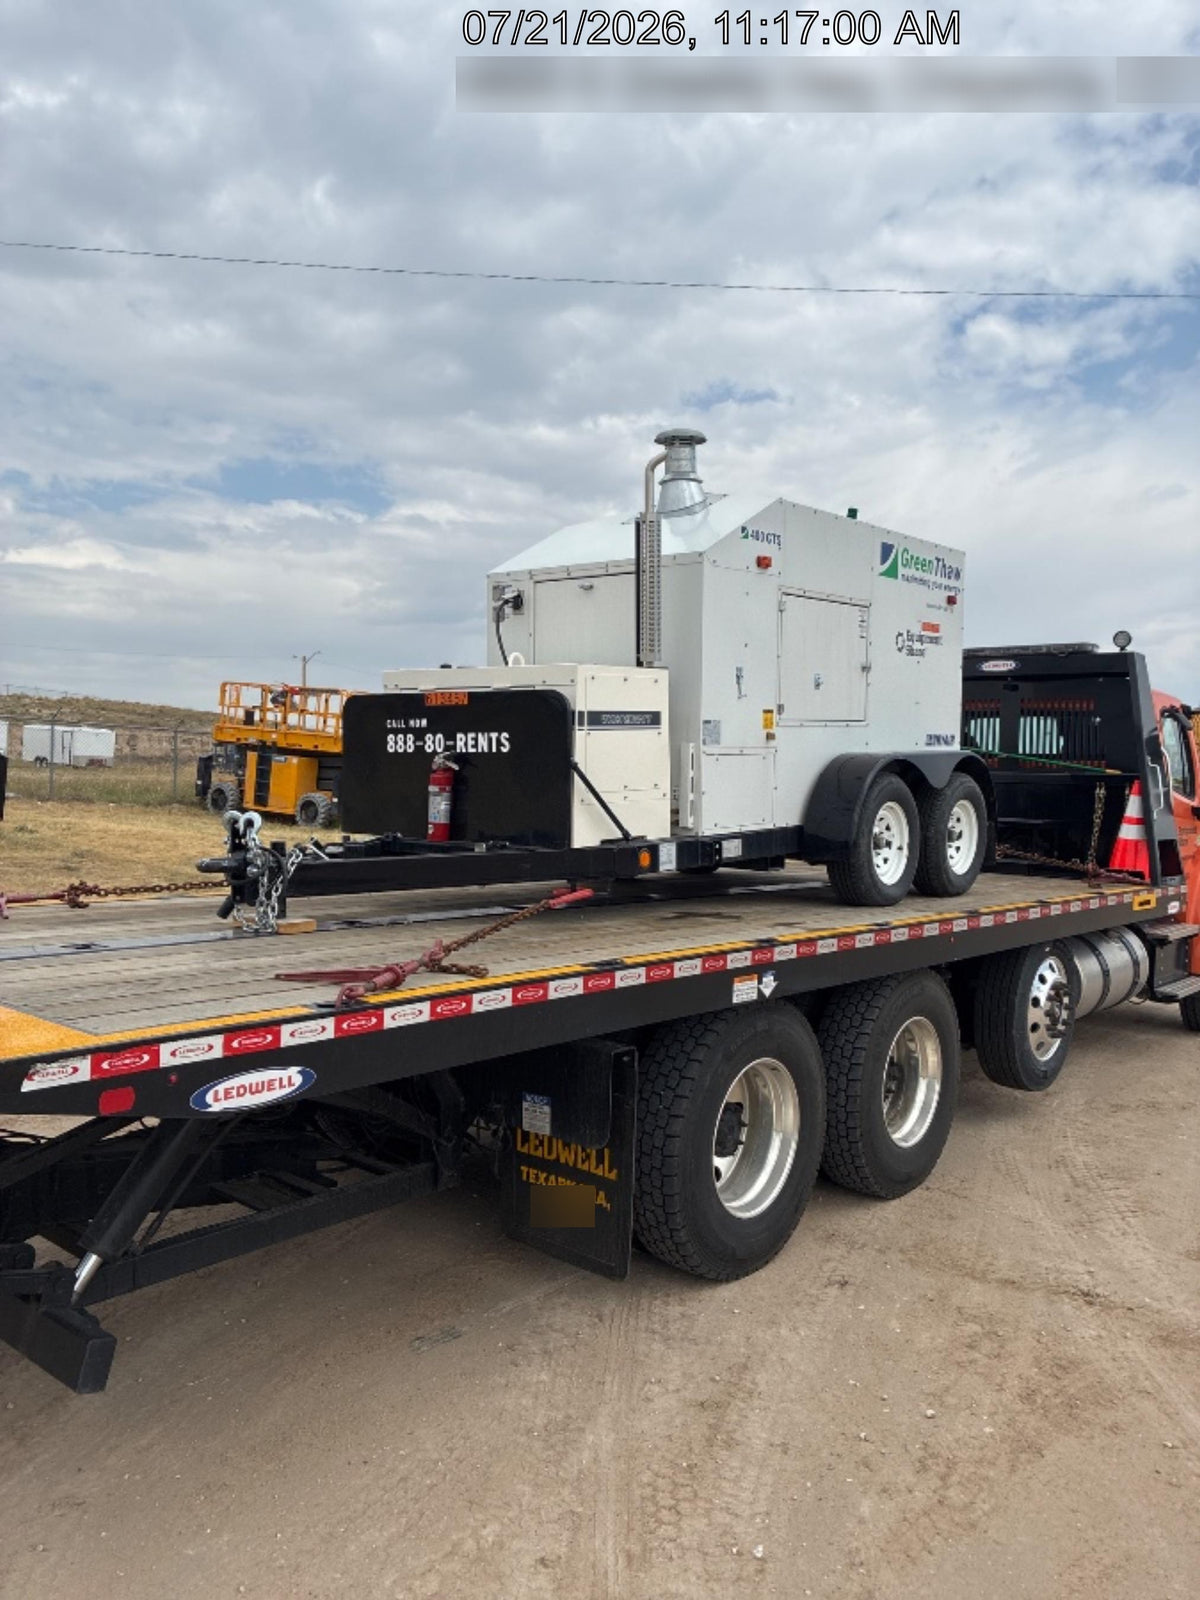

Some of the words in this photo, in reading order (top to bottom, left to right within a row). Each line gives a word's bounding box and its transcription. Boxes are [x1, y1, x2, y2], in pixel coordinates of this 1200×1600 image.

[386, 719, 406, 728] CALL
[408, 718, 428, 728] NOW
[386, 732, 511, 753] 888-80-RENTS
[212, 1075, 296, 1103] LEDWELL
[516, 1126, 618, 1181] LEDWELL
[520, 1165, 611, 1212] TEXARA,
